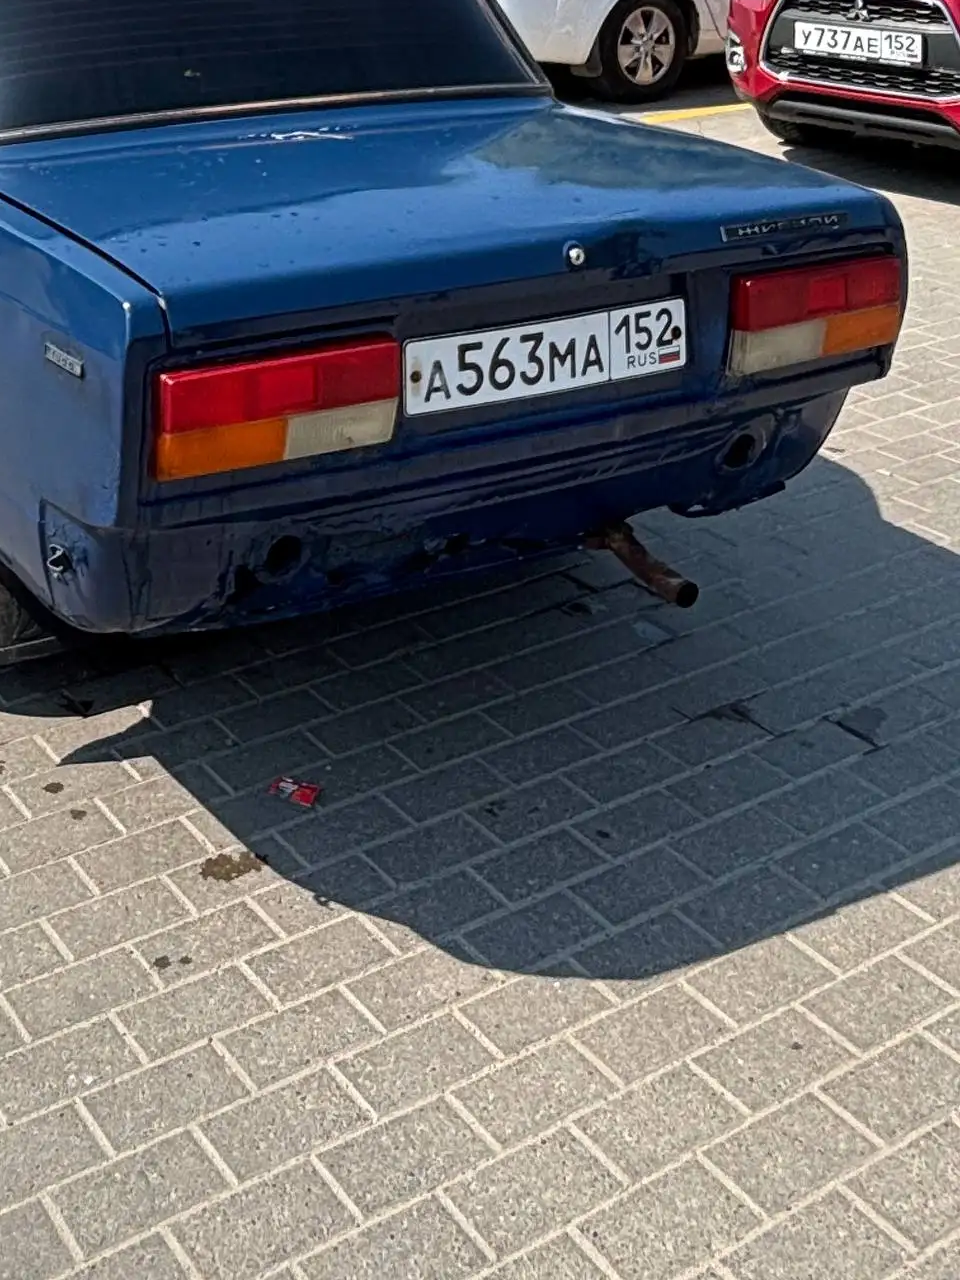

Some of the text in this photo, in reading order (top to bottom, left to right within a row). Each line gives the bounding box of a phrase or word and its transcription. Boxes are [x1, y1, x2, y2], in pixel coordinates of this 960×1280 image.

[801, 27, 916, 54] У737АЕ 152
[423, 307, 674, 403] А563МА 152
[627, 354, 657, 369] RUS
